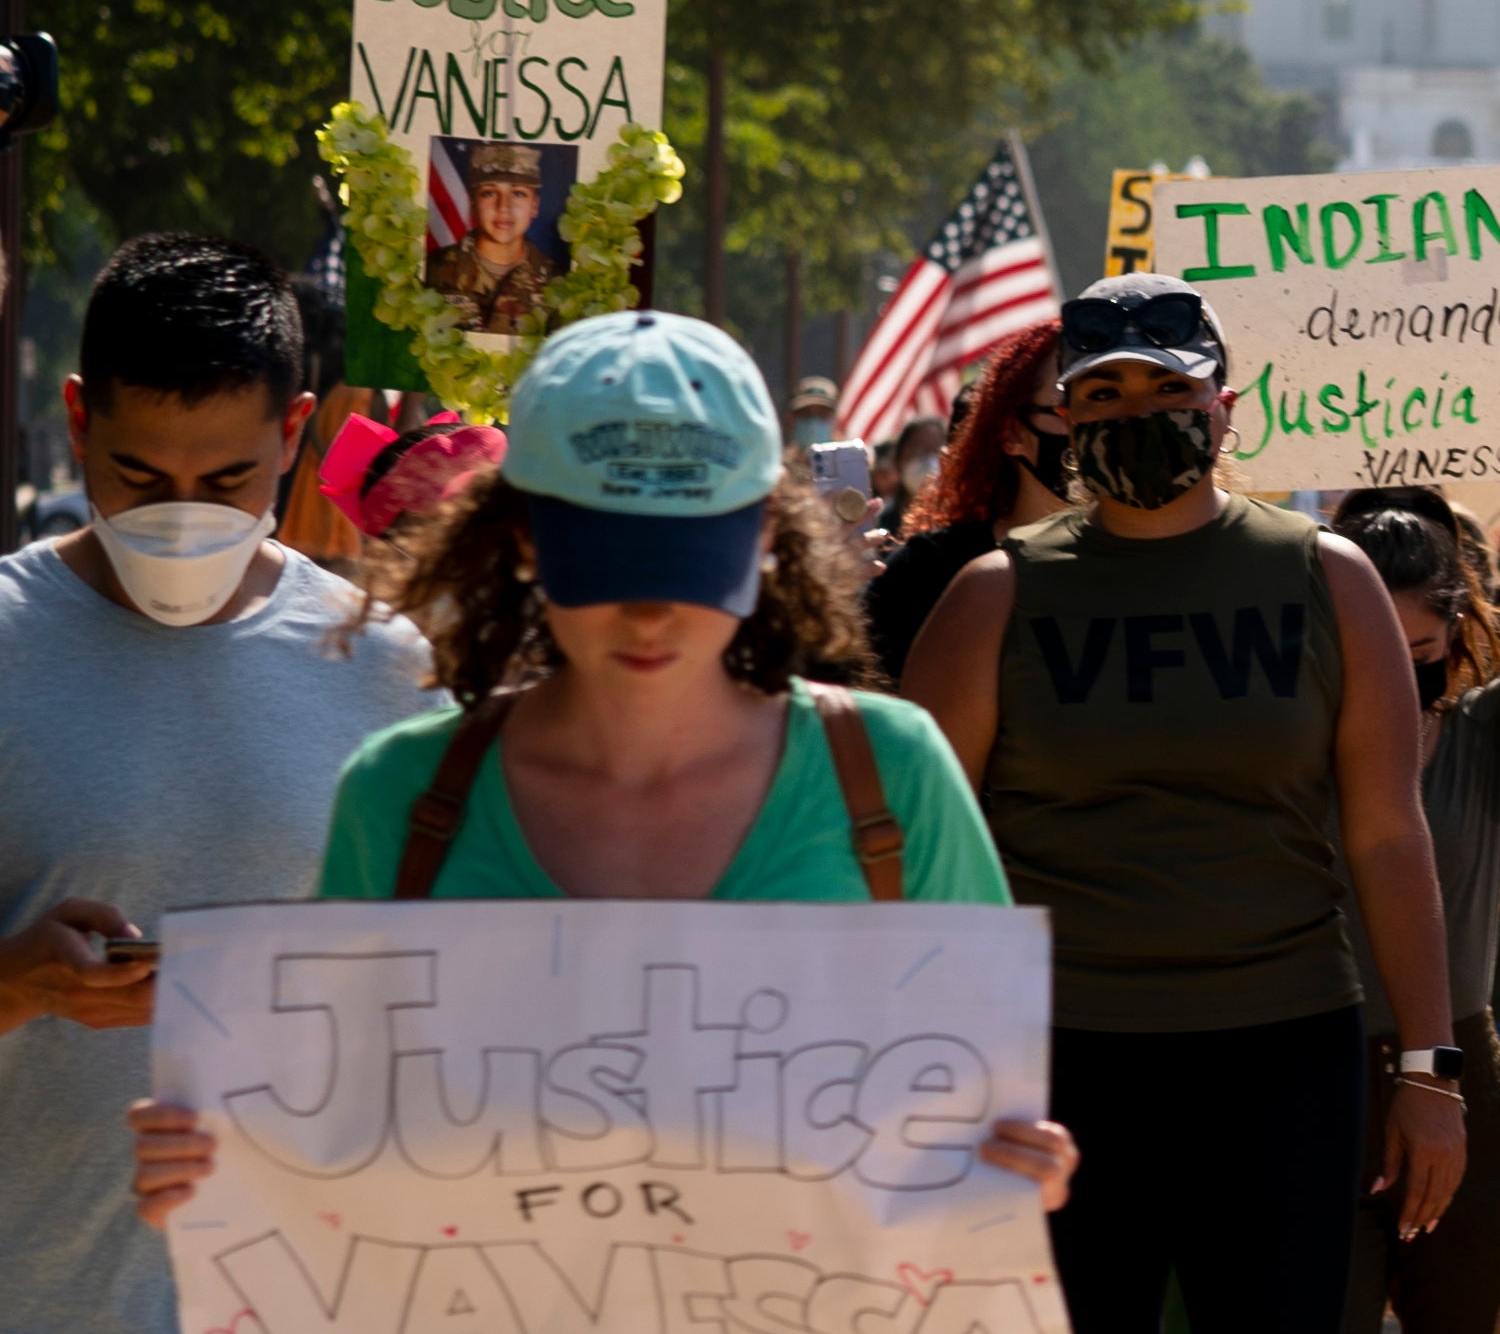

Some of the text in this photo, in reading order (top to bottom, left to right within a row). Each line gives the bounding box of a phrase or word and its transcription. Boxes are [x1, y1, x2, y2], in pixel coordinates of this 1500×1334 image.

[357, 43, 633, 141] VANESSA
[460, 19, 533, 78] for
[1233, 361, 1480, 460] Justicia
[1029, 603, 1304, 704] VFW
[224, 950, 991, 1192] Justice
[513, 1181, 694, 1225] FOR
